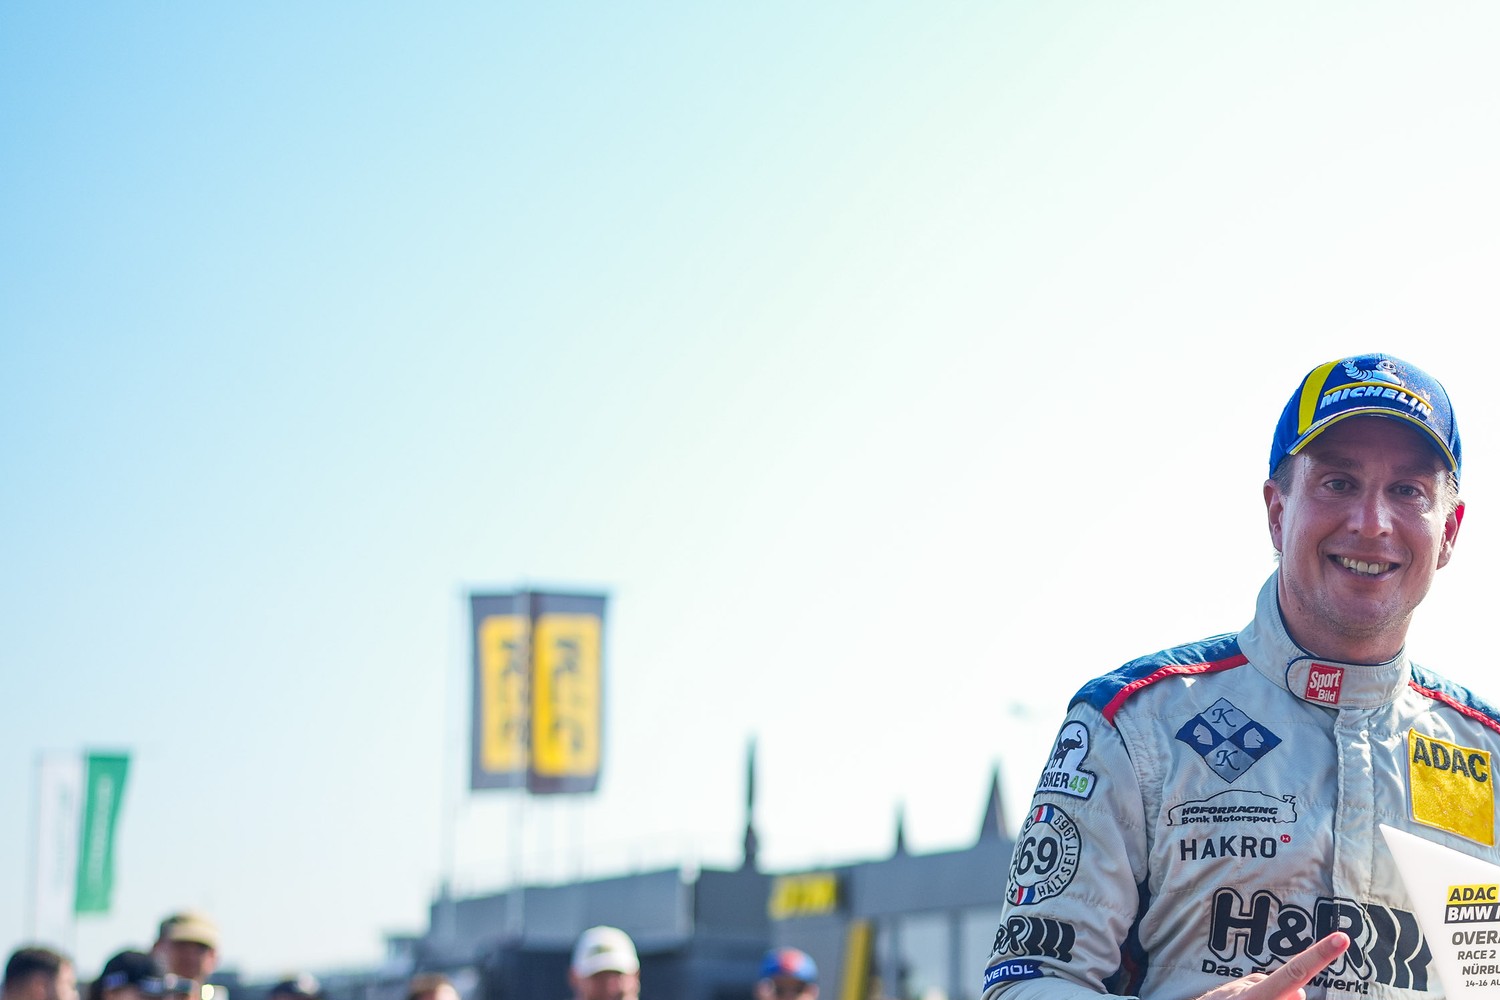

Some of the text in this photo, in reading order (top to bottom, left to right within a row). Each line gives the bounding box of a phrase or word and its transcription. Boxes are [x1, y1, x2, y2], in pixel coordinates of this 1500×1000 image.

[1319, 386, 1432, 419] MICHELIN
[1309, 669, 1341, 690] Sport
[1317, 688, 1337, 702] Bild
[1212, 707, 1236, 728] K
[1216, 749, 1240, 771] K
[1413, 737, 1488, 783] ADAC
[1181, 815, 1277, 824] Bonk Motorsport
[1017, 836, 1058, 876] 69
[1180, 836, 1277, 860] HAKRO
[1449, 886, 1497, 901] ADAC
[1447, 905, 1492, 921] BMW
[1208, 887, 1373, 980] H&R
[1457, 950, 1496, 960] RACE 2
[1202, 960, 1243, 977] Das
[1466, 979, 1488, 987] 14-16
